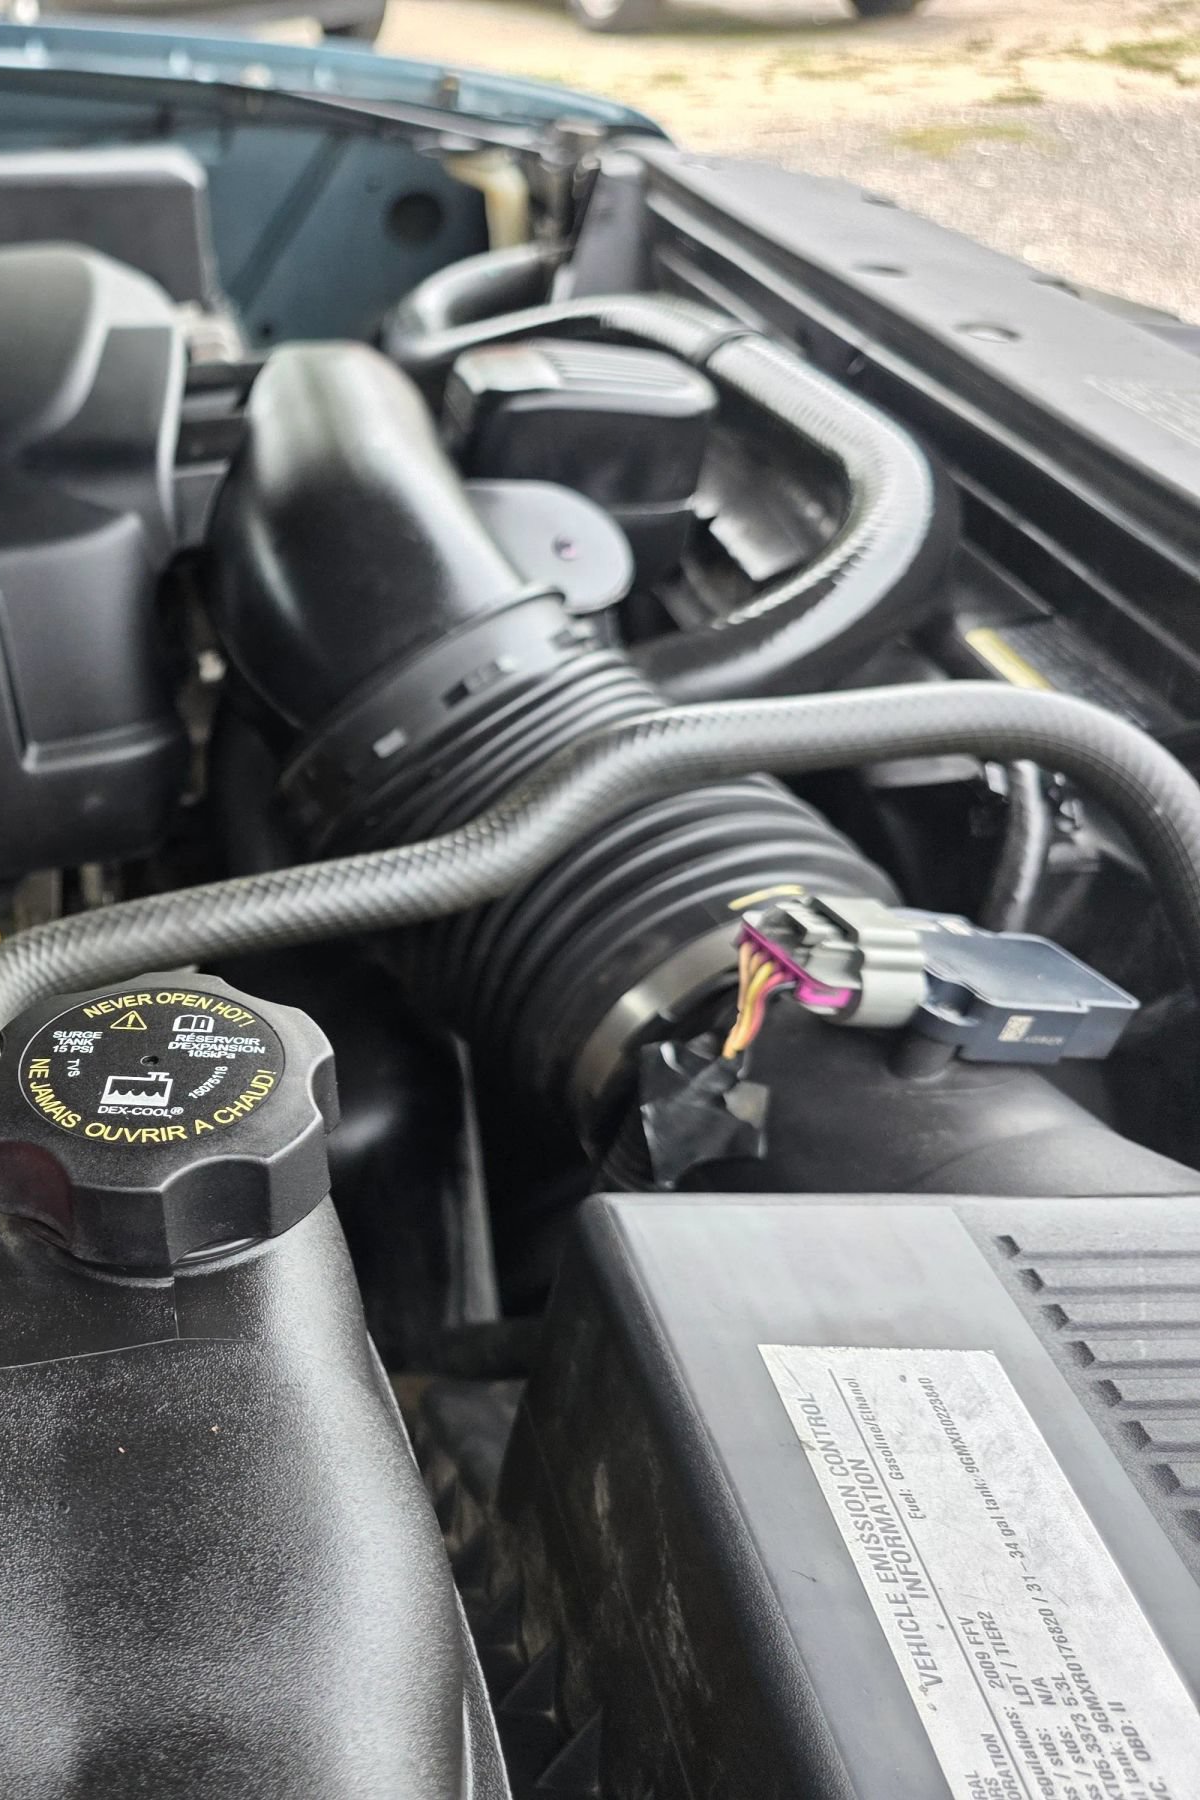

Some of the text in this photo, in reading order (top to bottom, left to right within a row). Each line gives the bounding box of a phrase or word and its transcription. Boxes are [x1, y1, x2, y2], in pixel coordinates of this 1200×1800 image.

[83, 992, 256, 1028] NEVER OPEN HOT!
[52, 1031, 103, 1039] SURGE
[52, 1045, 94, 1053] 15 PSI
[58, 1038, 94, 1046] TANK
[167, 1042, 266, 1054] D'EXPANSION
[175, 1033, 261, 1046] RÉSERVOIR
[67, 1058, 80, 1077] TVS
[187, 1049, 236, 1059] 105kPa
[188, 1065, 229, 1099] 15075118
[28, 1058, 277, 1143] NE JAMAIS OUVRIR A CHAUD!
[842, 1377, 905, 1481] Gasoline/Ethanol
[797, 1392, 944, 1687] VEHICLE EMISSION CONTROL
[846, 1458, 930, 1599] INFORMATION
[989, 1515, 1017, 1537] gal
[976, 1610, 1010, 1656] TIER2
[1037, 1608, 1115, 1734] 9GMXR0176820
[1050, 1671, 1079, 1707] 5.3L
[1005, 1673, 1036, 1706] LDT
[1030, 1676, 1057, 1706] N/A
[956, 1616, 1056, 1800] egulations: 2009 FFV
[1035, 1728, 1064, 1767] stds:
[1056, 1725, 1086, 1765] stds:
[1120, 1720, 1152, 1762] OBD:
[980, 1733, 1022, 1800] ORATION
